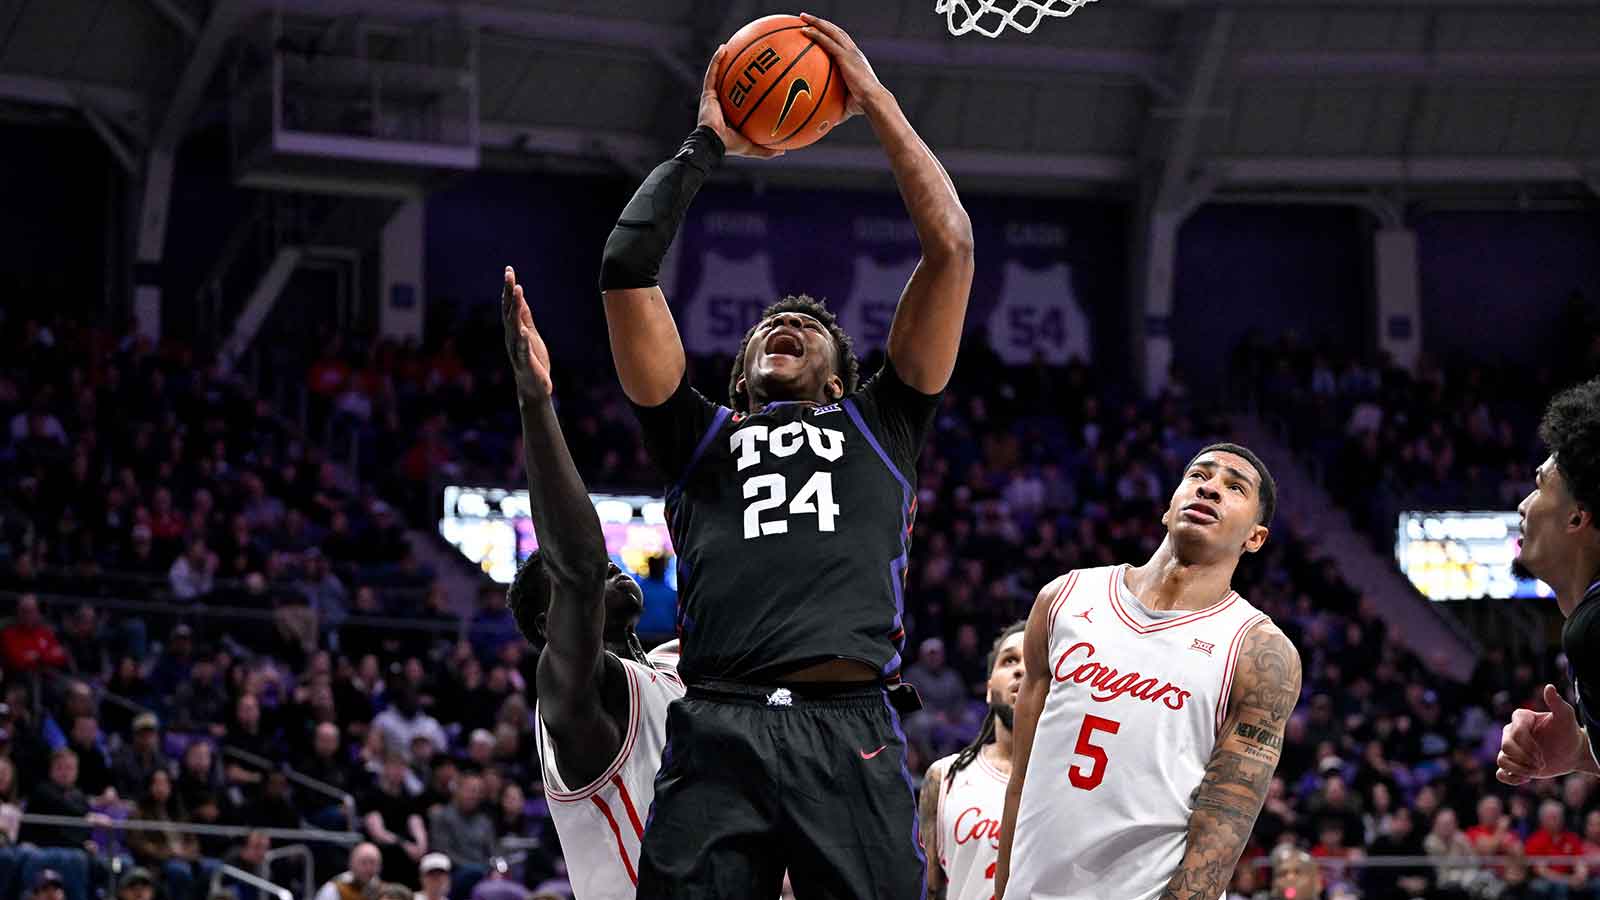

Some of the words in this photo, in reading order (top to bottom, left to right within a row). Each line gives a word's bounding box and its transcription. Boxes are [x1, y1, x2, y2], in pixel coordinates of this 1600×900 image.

[728, 47, 781, 109] ELITE
[1008, 307, 1066, 350] 54
[729, 419, 846, 472] TCU
[742, 471, 840, 539] 24
[1055, 642, 1191, 710] Cougars
[1068, 713, 1121, 791] 5
[954, 807, 1000, 850] Cou
